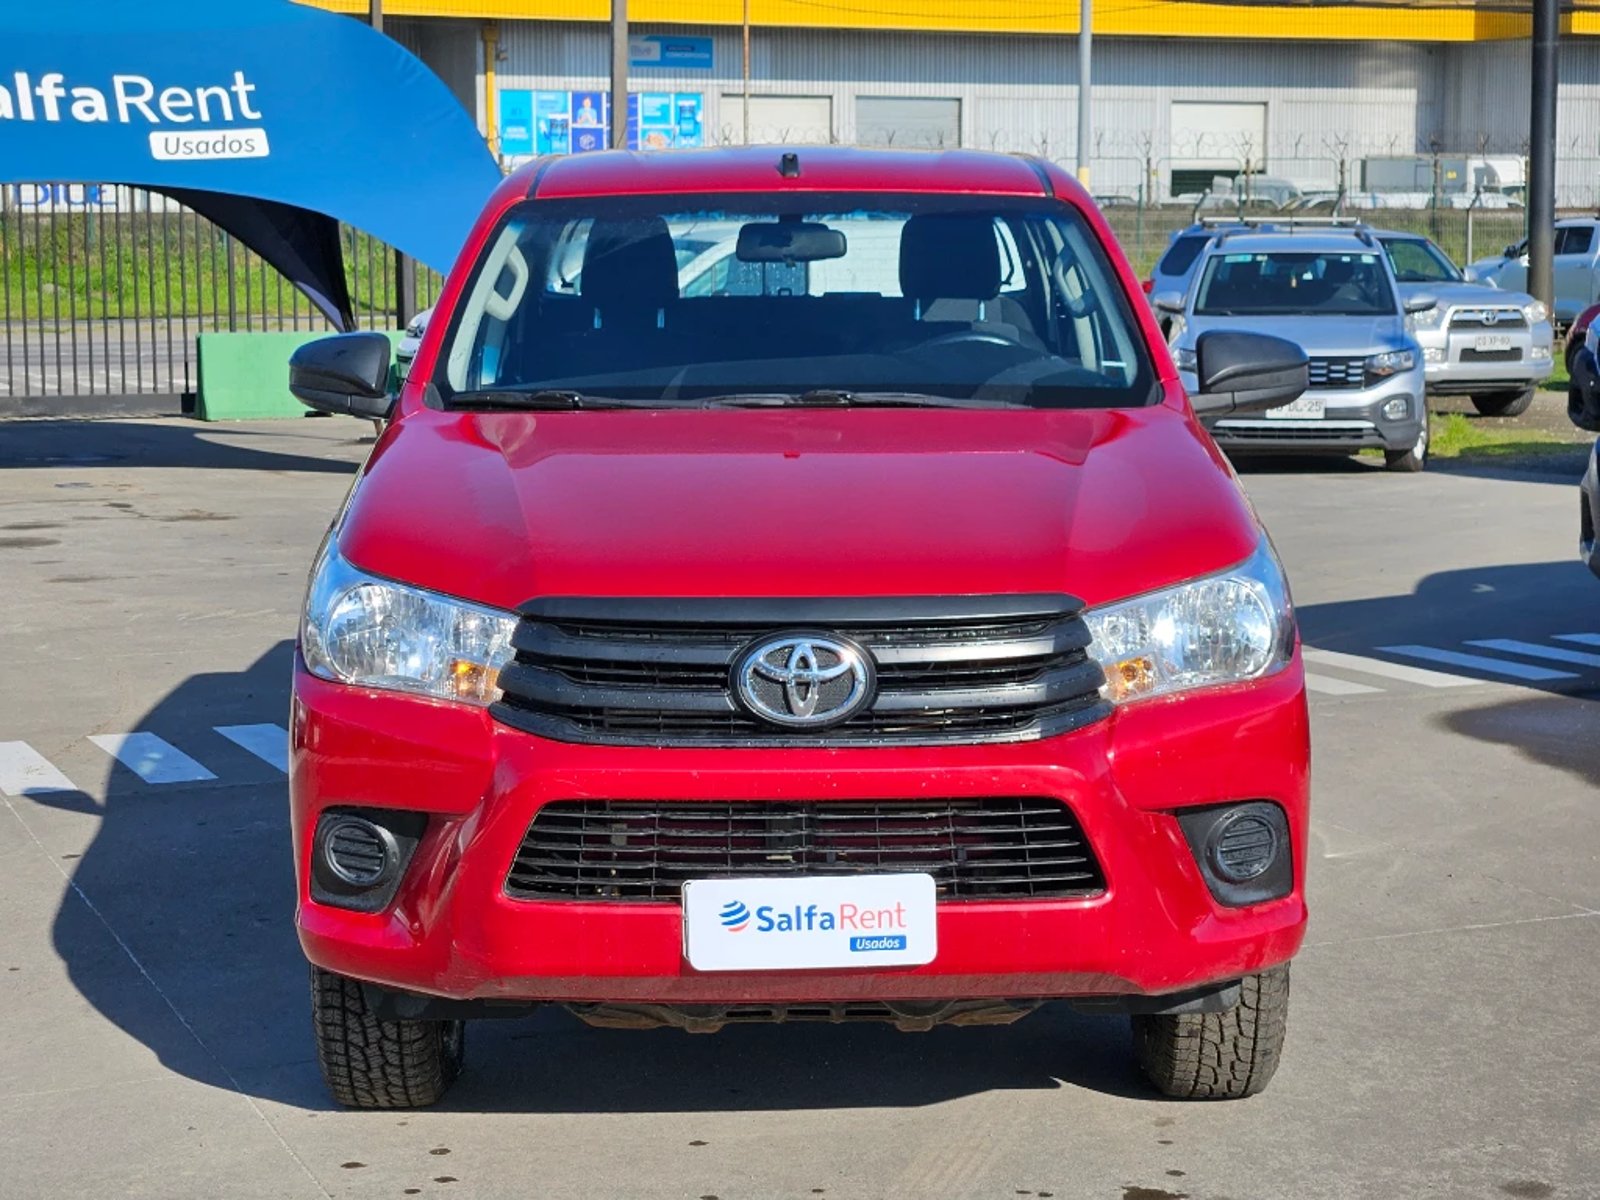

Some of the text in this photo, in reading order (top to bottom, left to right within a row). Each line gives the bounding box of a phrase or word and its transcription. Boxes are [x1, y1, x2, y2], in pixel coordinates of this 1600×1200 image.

[164, 134, 256, 156] Usados
[756, 901, 907, 932] SalfaRent
[855, 937, 900, 950] Usados
